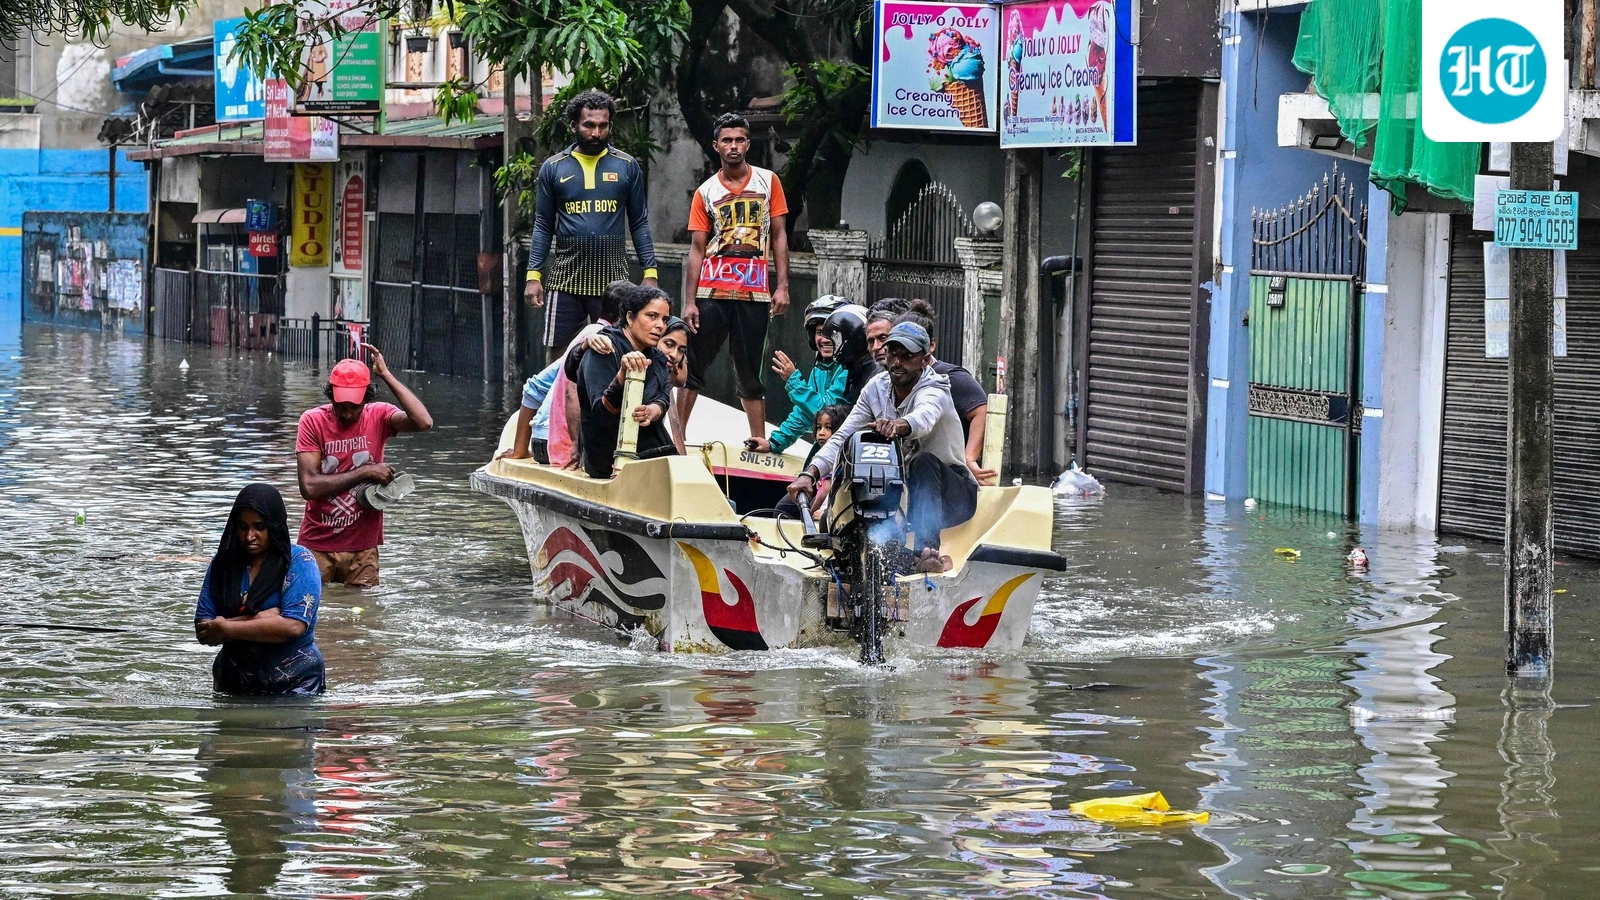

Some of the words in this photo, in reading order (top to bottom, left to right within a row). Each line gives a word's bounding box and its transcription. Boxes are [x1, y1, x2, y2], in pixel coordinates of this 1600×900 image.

[892, 12, 932, 25] JOLLY
[936, 16, 946, 26] O
[950, 16, 989, 28] JOLLY
[1023, 37, 1047, 58] JOLLY
[1048, 37, 1055, 55] O
[1057, 34, 1081, 55] JOLLY
[1008, 67, 1046, 96] Creamy
[1048, 65, 1062, 89] Ice
[1065, 63, 1100, 88] Cream
[266, 86, 274, 101] Sri
[274, 85, 287, 100] Lank
[895, 88, 953, 105] Creamy
[887, 102, 907, 116] Ice
[911, 104, 960, 118] Cream
[300, 164, 324, 256] STUDIO
[565, 199, 592, 215] GREAT
[594, 200, 617, 213] BOYS
[251, 233, 275, 244] airtel
[1497, 217, 1517, 241] 077
[1520, 217, 1542, 243] 904
[1546, 219, 1575, 244] 0503
[255, 244, 270, 253] 4G
[324, 435, 368, 455] MORTEM
[861, 445, 891, 458] 25
[739, 450, 785, 469] SNL-514
